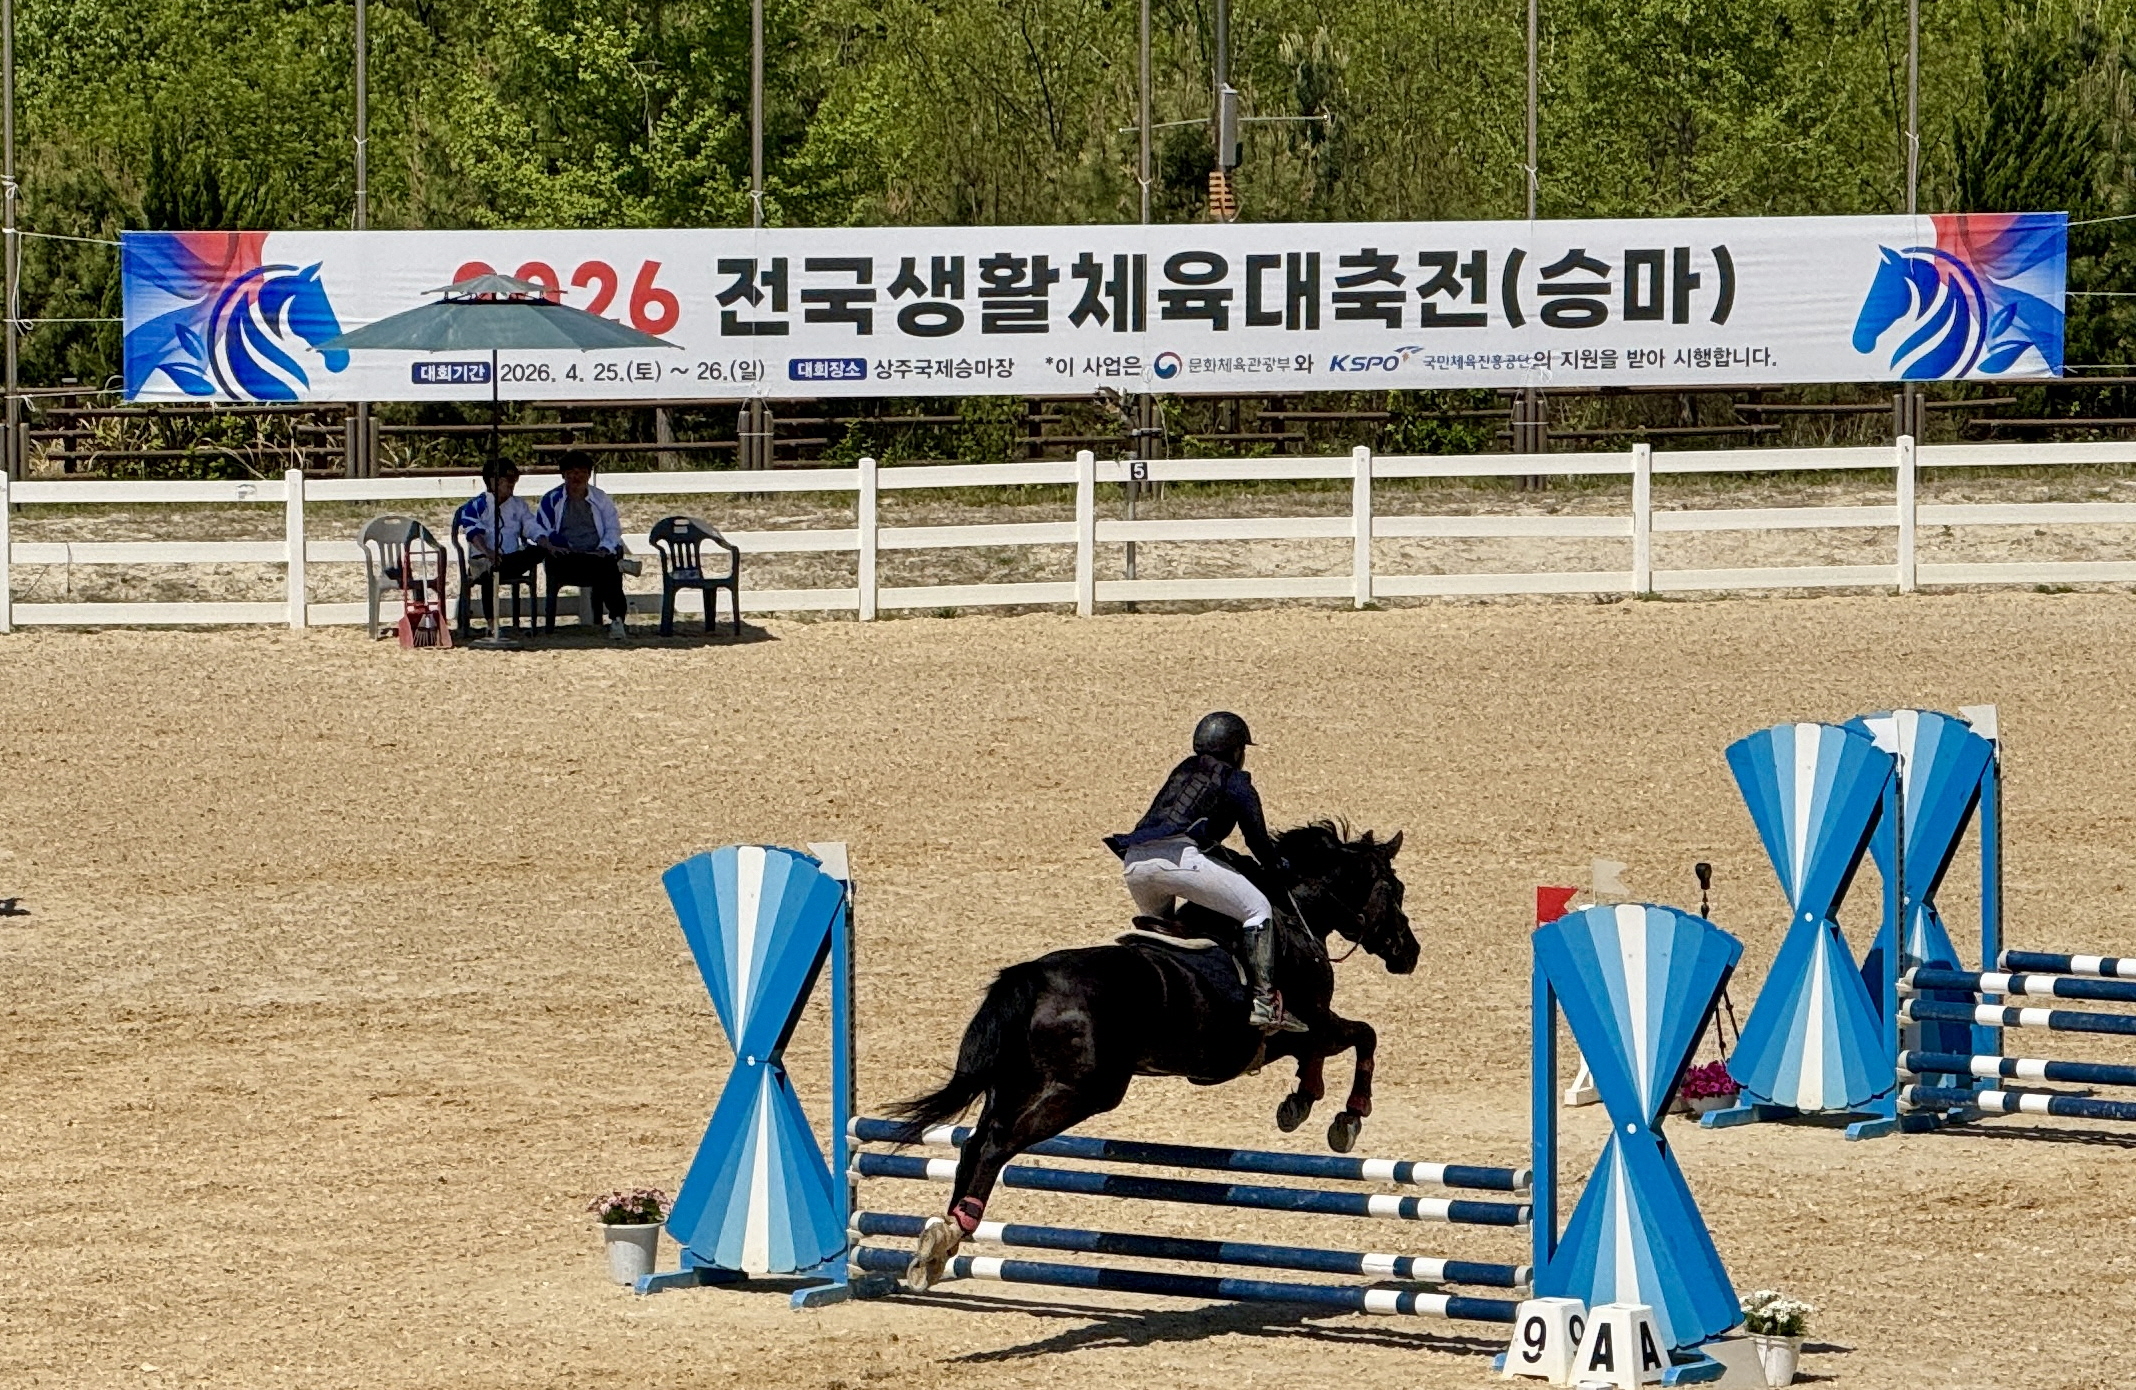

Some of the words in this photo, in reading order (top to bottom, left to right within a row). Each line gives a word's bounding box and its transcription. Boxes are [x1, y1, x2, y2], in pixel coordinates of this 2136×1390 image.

[716, 244, 1736, 336] 전국생활체육대축전(승마)
[420, 364, 486, 382] 대회기간
[499, 363, 556, 382] 2026.
[565, 363, 585, 382] 4.
[593, 359, 662, 384] 25.(토)
[697, 358, 765, 383] 26.(일)
[797, 360, 861, 379] 대회장소
[873, 357, 1015, 380] 상주국제승마장
[1082, 355, 1143, 378] 사업은
[1328, 354, 1400, 372] KSPO
[1560, 349, 1619, 371] 지원을
[1626, 348, 1666, 370] 받아
[1673, 346, 1777, 369] 시행합니다.
[1134, 462, 1145, 479] 5
[1522, 1316, 1547, 1364] 9
[1588, 1322, 1615, 1372] A
[1639, 1320, 1662, 1372] A
